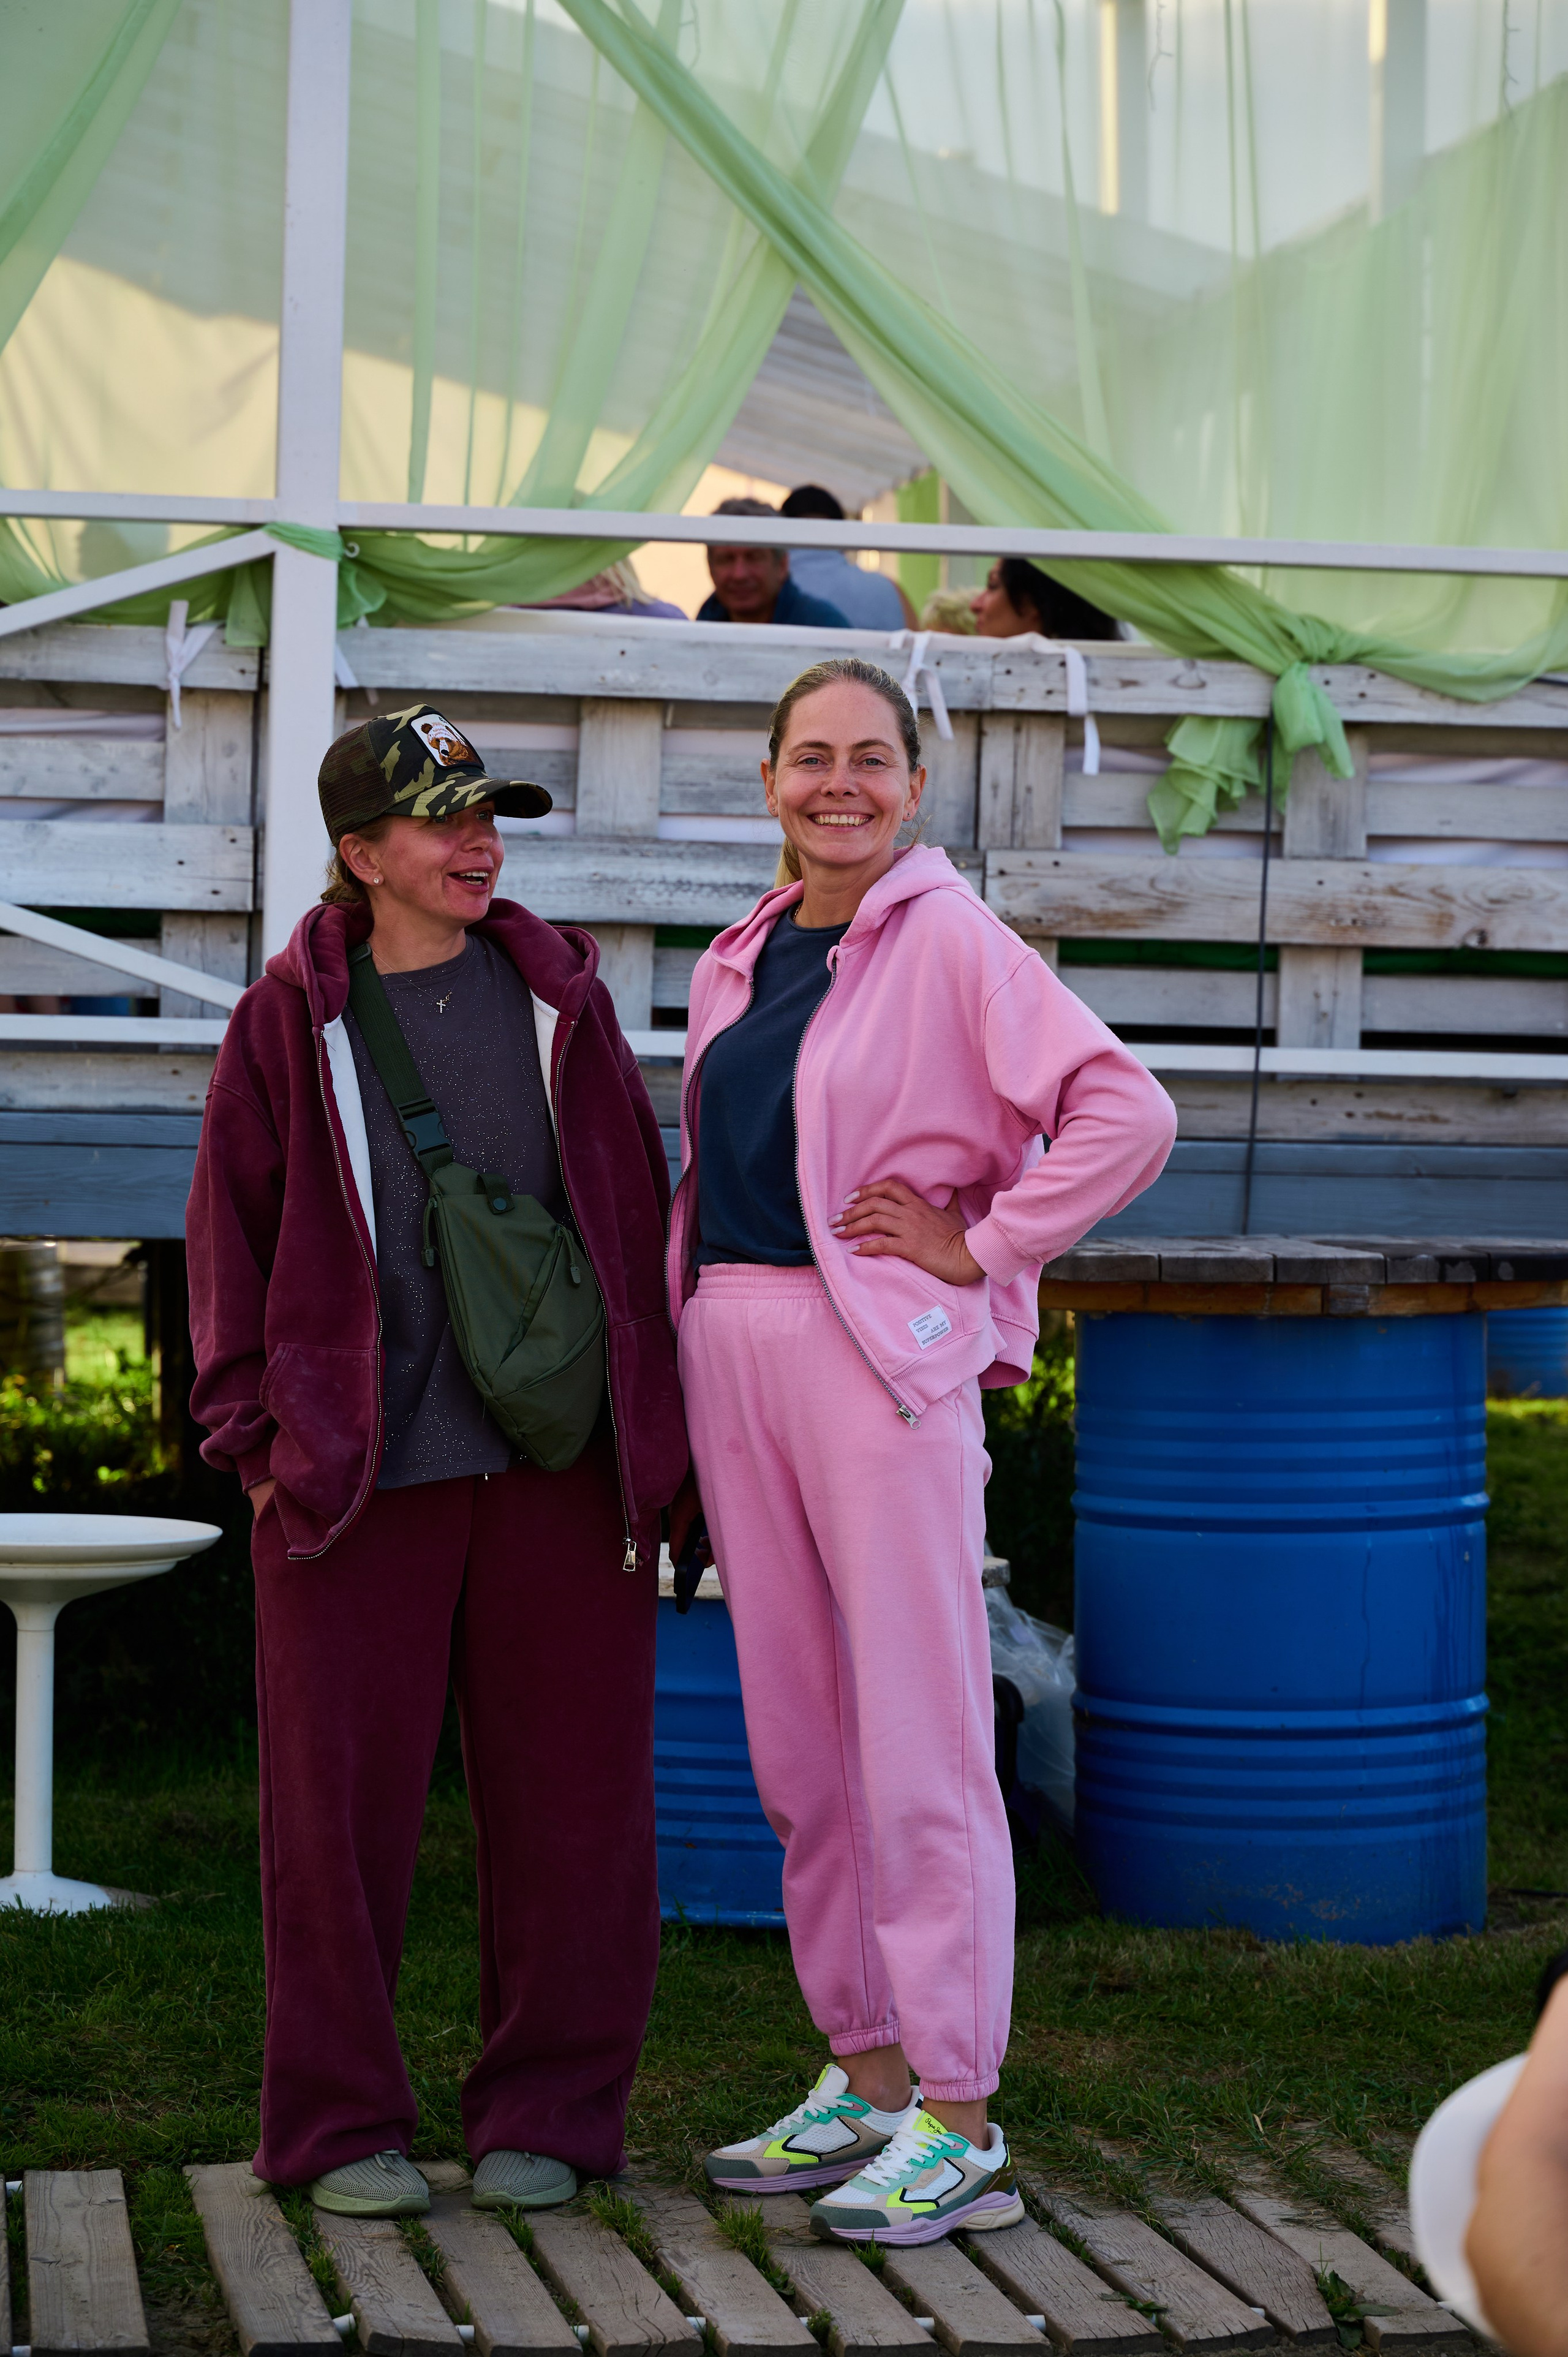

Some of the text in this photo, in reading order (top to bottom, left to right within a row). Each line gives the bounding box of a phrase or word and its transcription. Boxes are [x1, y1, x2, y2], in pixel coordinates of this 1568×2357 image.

[913, 1314, 932, 1327] POSITIVE
[916, 1324, 929, 1333] VIBES
[922, 1326, 949, 1345] SUPERPOWER
[925, 2118, 935, 2129] Pepe
